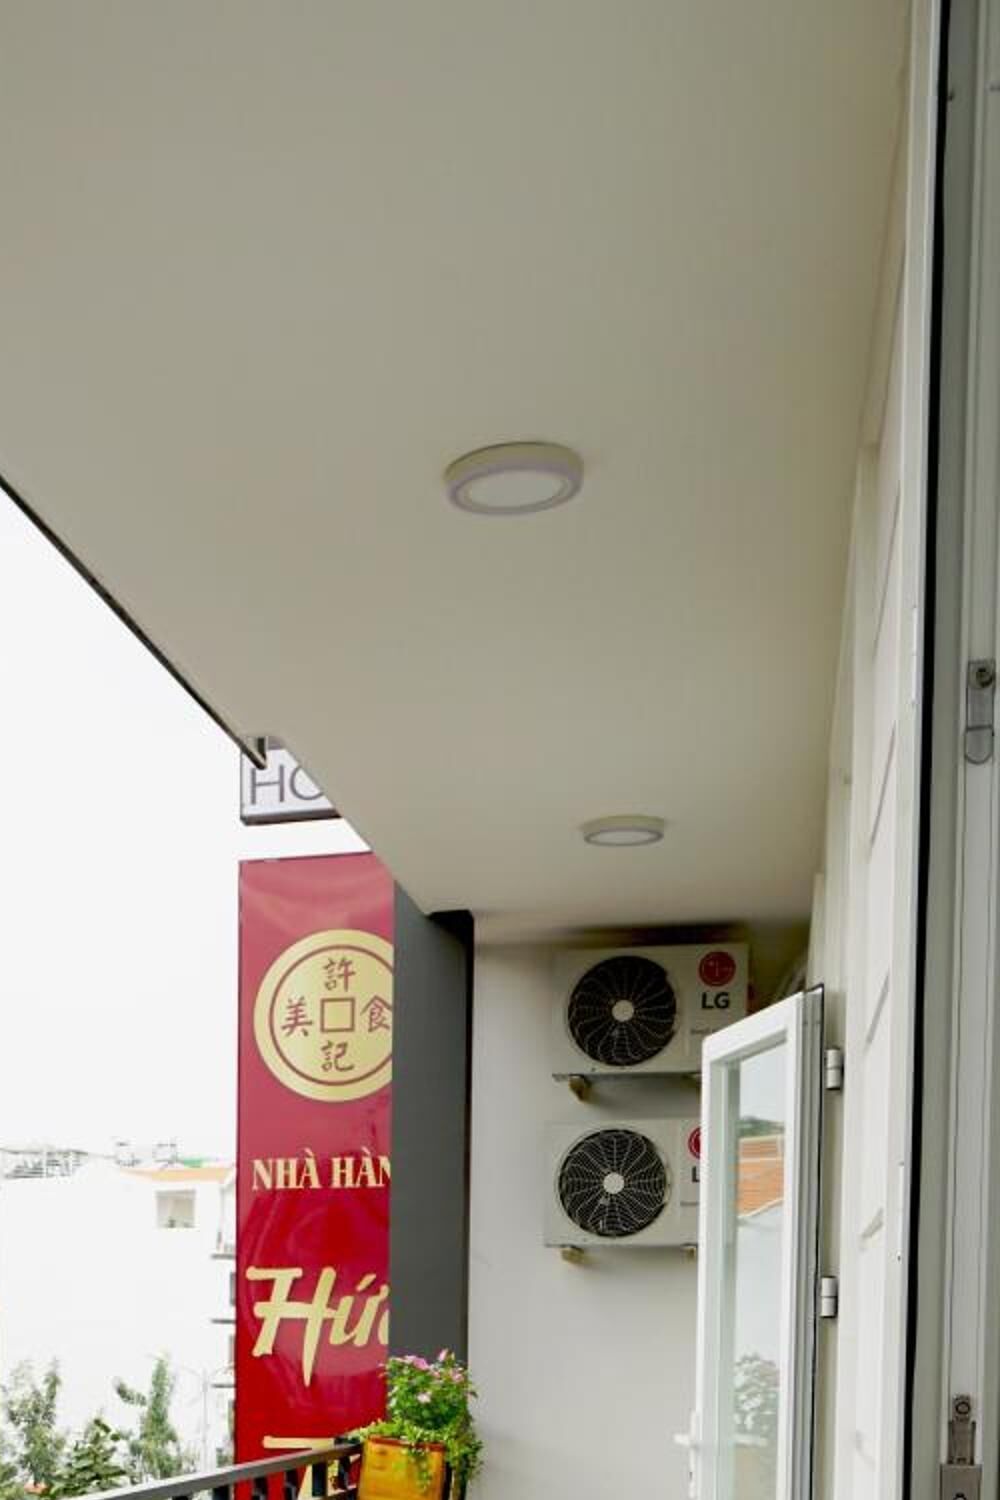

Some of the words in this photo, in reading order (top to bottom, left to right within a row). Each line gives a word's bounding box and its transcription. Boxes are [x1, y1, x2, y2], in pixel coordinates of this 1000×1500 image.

[323, 957, 356, 992] 許
[701, 987, 730, 1010] LG
[281, 996, 313, 1037] 美
[360, 995, 393, 1033] 食
[321, 1040, 355, 1072] 記
[252, 1147, 322, 1191] NHÀ
[691, 1166, 700, 1183] L
